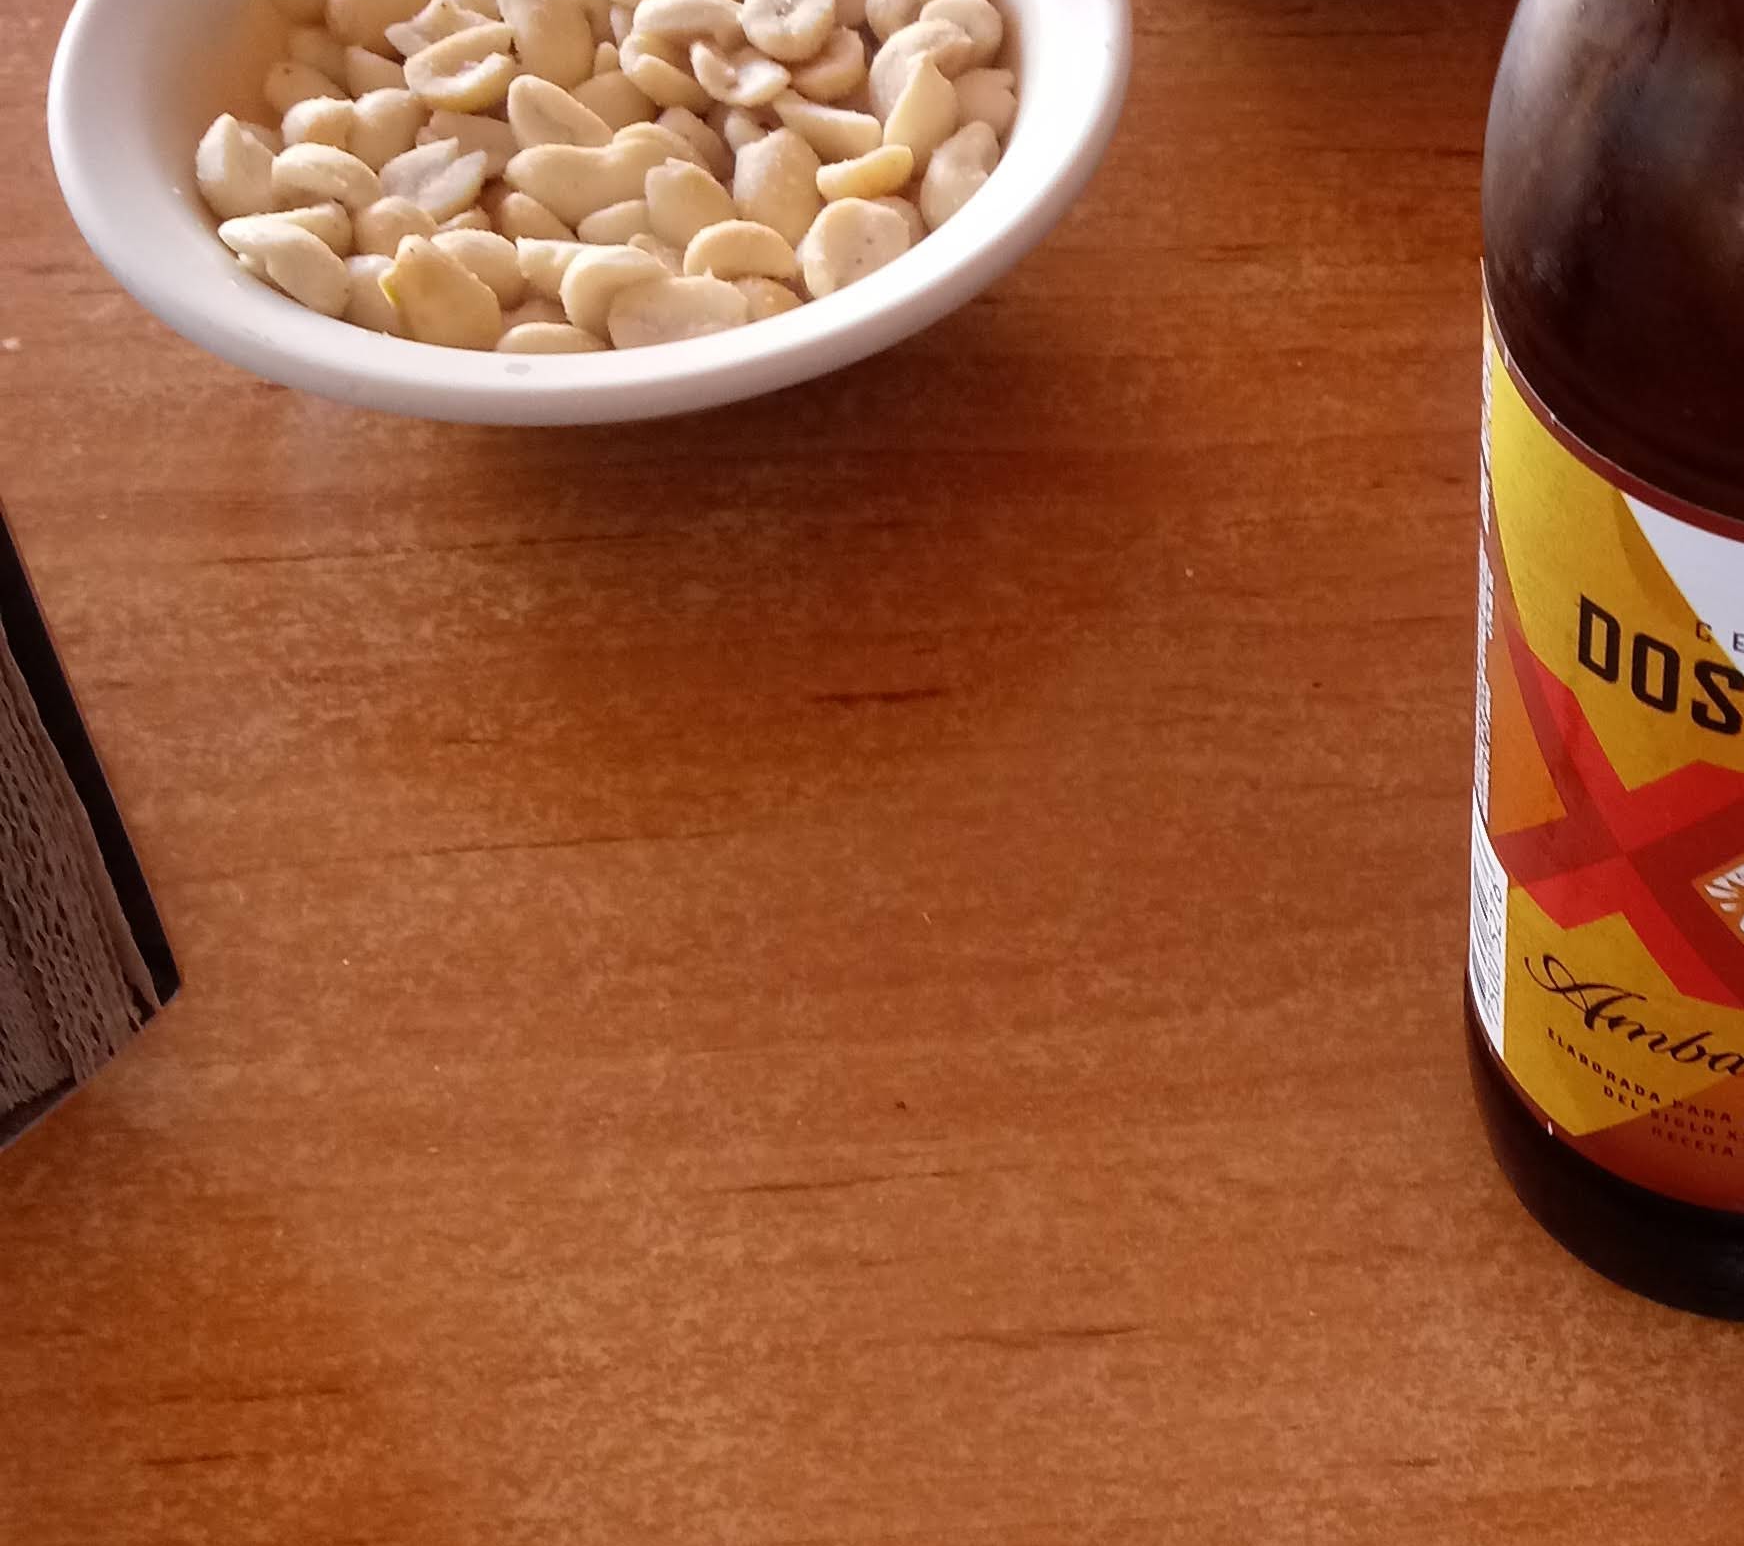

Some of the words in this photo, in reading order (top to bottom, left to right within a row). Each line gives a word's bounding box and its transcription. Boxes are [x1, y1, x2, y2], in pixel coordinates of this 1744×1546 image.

[1547, 1026, 1661, 1104] ELABORADA
[1671, 1097, 1733, 1124] PARA
[1603, 1084, 1639, 1112] DEL
[1650, 1108, 1715, 1136] SIGLO
[1651, 1126, 1735, 1159] RECETA
